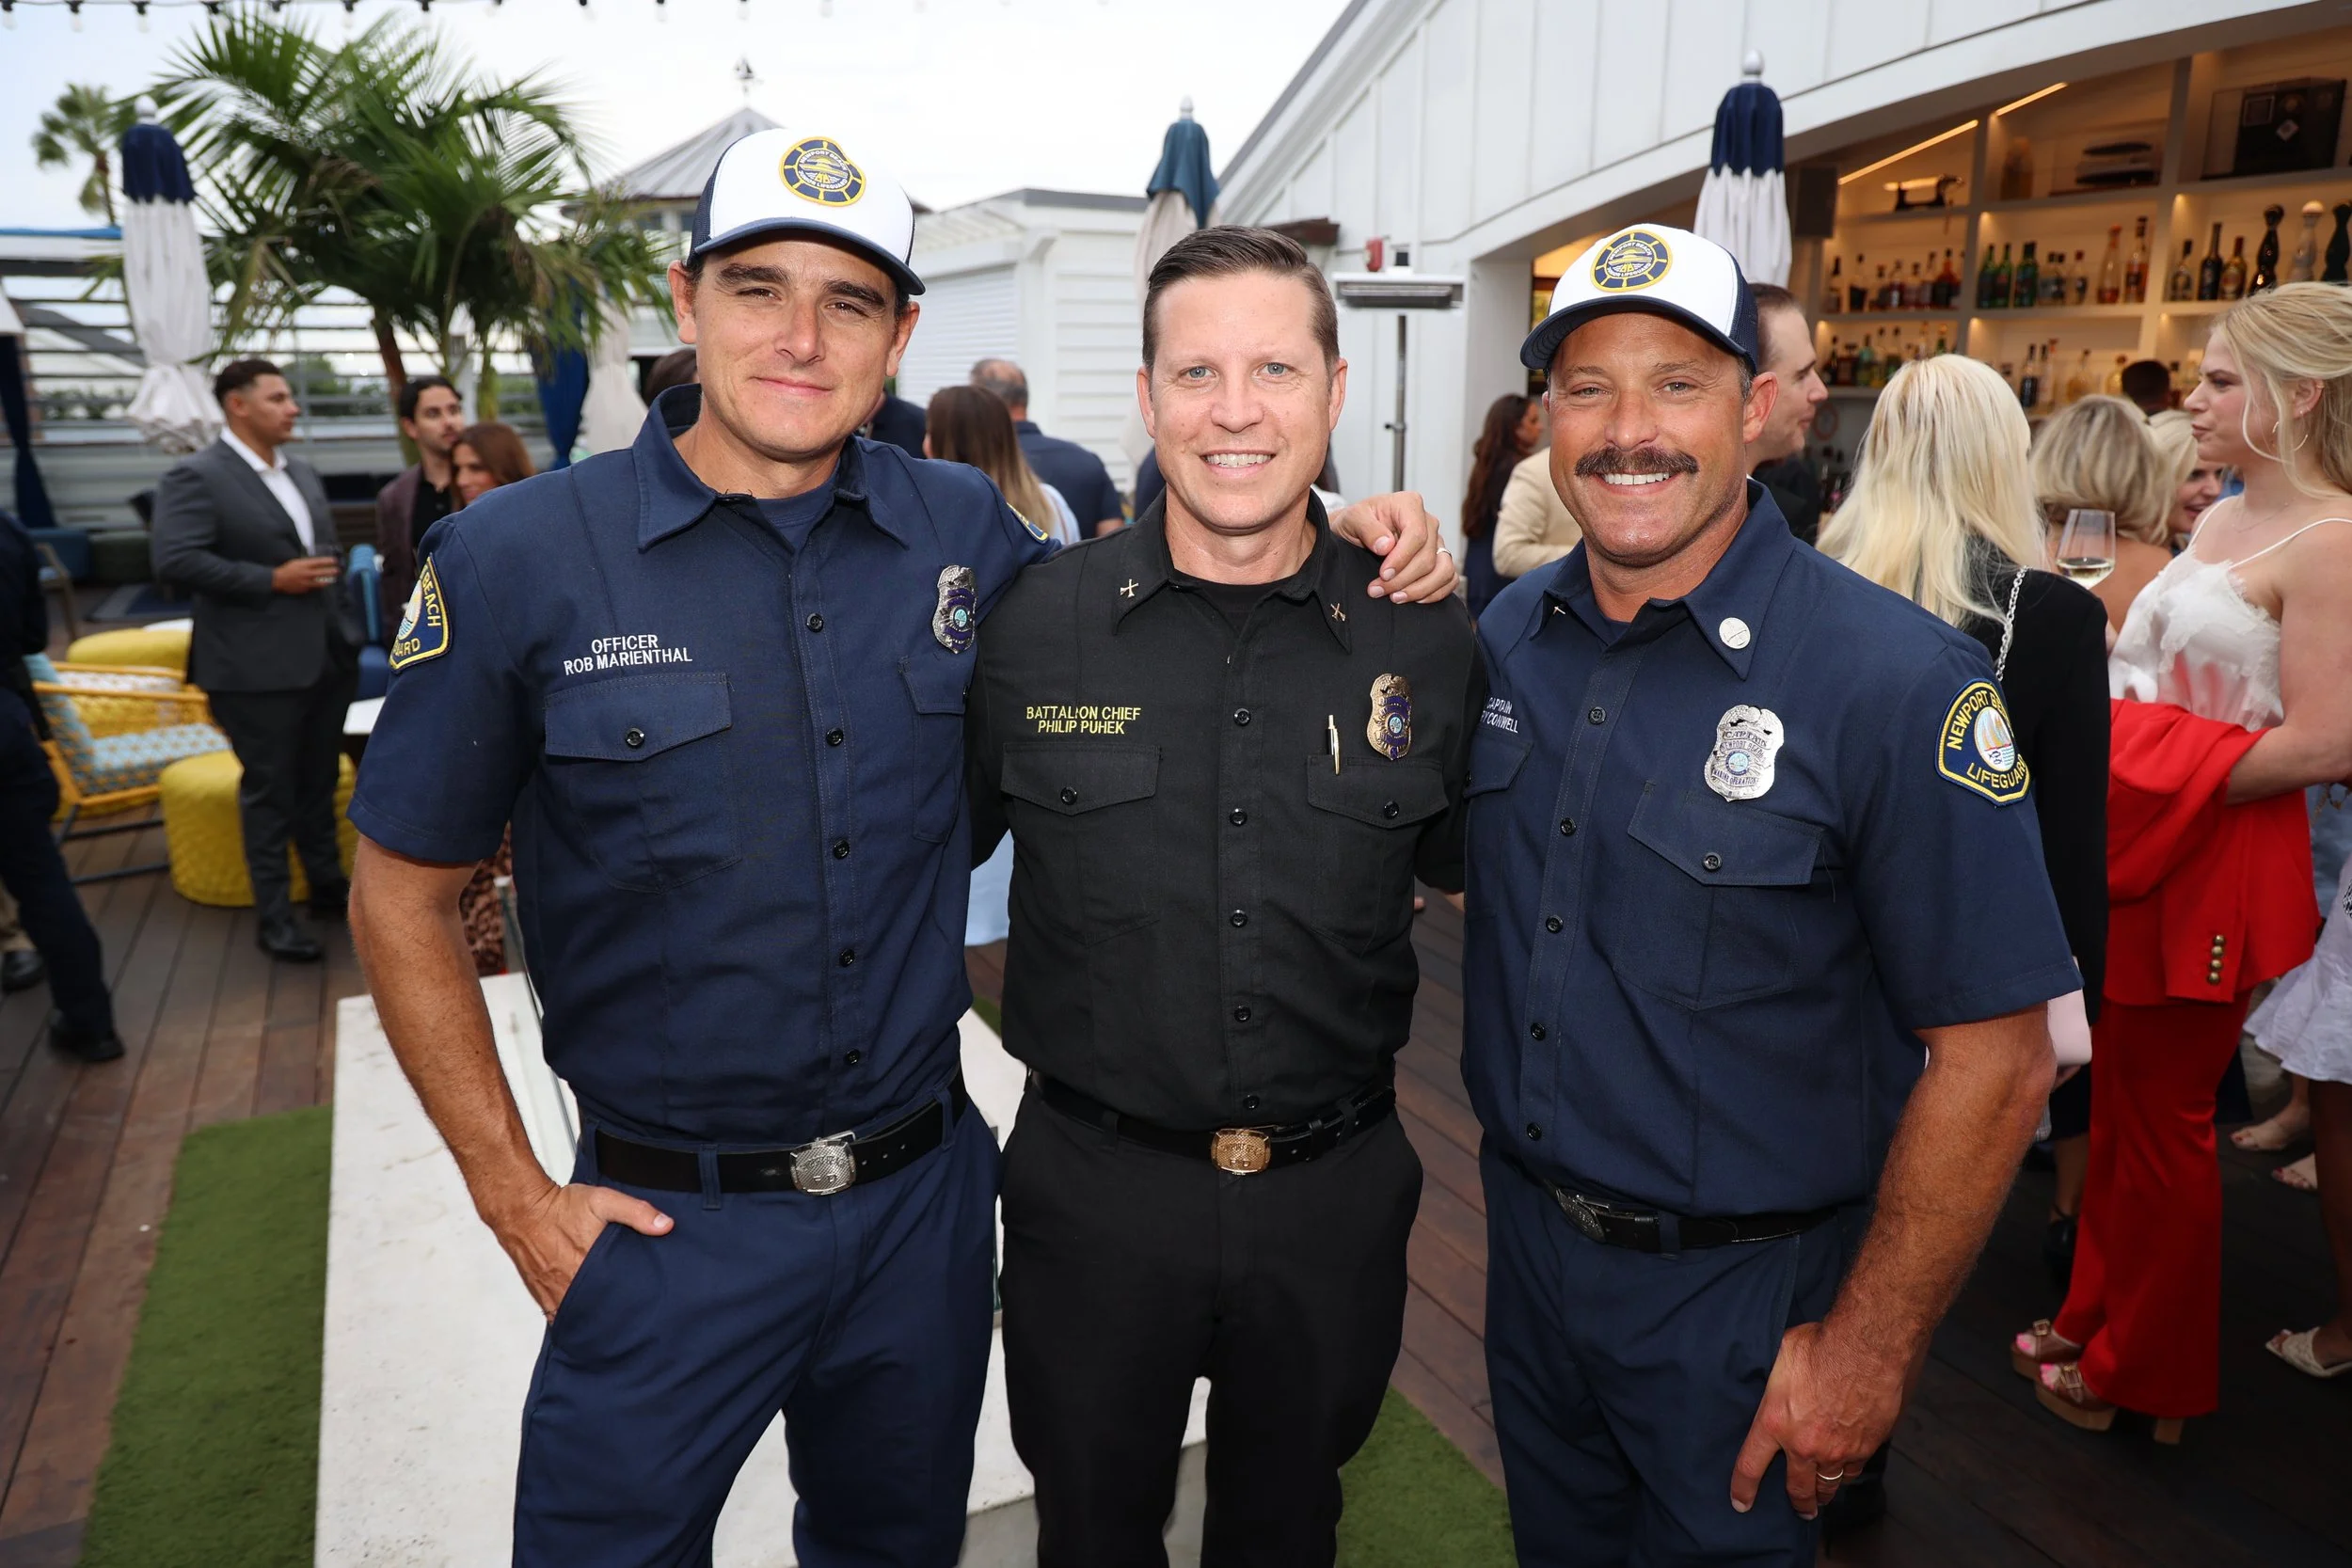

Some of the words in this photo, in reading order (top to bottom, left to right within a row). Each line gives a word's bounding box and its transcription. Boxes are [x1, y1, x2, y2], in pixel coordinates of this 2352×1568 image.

[1635, 242, 1652, 255] BEACH
[421, 572, 441, 626] BEACH
[591, 634, 659, 655] OFFICER
[564, 657, 594, 676] ROB
[596, 647, 693, 670] MARIENTHAL
[1025, 705, 1099, 721] BATTALION
[1101, 706, 1142, 721] CHIEF
[1486, 697, 1513, 715] CAPTAIN
[1038, 720, 1078, 734] PHILIP
[1080, 721, 1125, 735] PUHEK
[1486, 712, 1518, 734] CONWELL
[1947, 689, 1990, 751] NEWPORT
[1722, 740, 1747, 752] NEWPORT
[1725, 730, 1767, 747] CAPTAIN
[1966, 753, 2026, 789] LIFEGUARD
